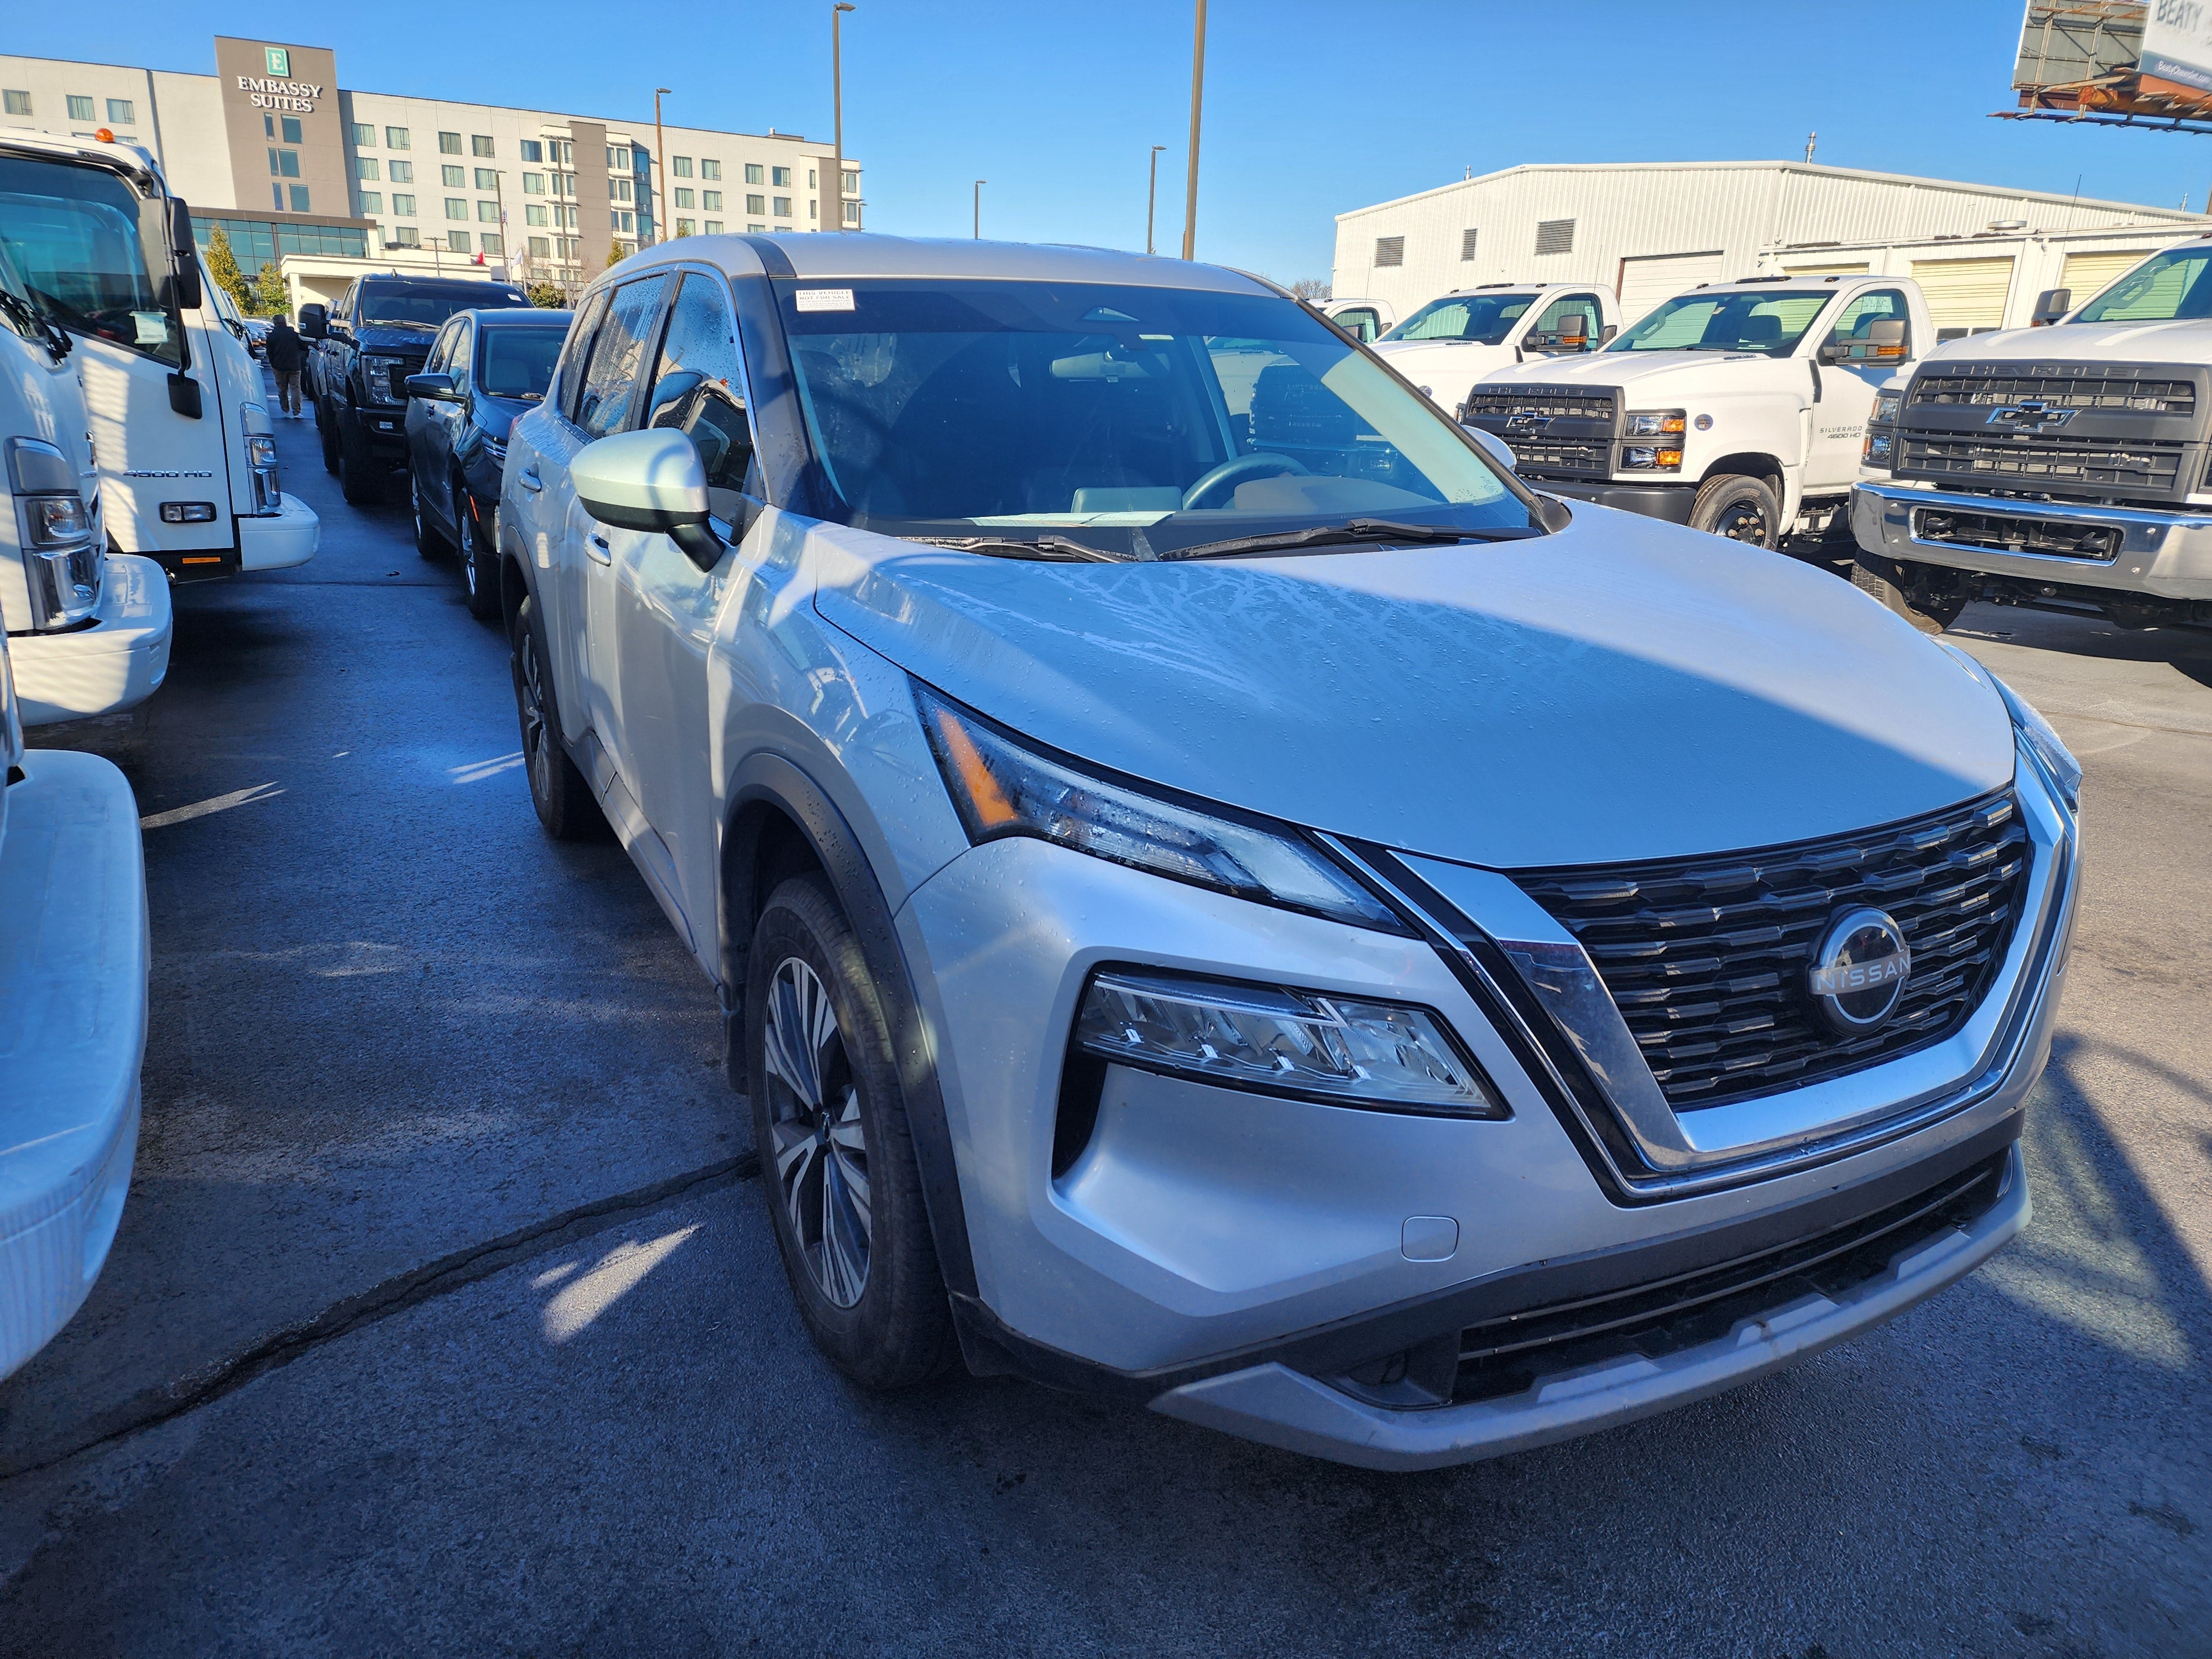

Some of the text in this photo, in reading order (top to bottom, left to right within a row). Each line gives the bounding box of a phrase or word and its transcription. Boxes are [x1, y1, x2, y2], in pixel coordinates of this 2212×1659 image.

[236, 76, 322, 98] EMBASSY
[250, 93, 314, 113] SUITES
[1952, 364, 2153, 378] CHEVROLET
[1489, 387, 1590, 396] CHEVROLET
[1817, 954, 1910, 990] NISSAN
